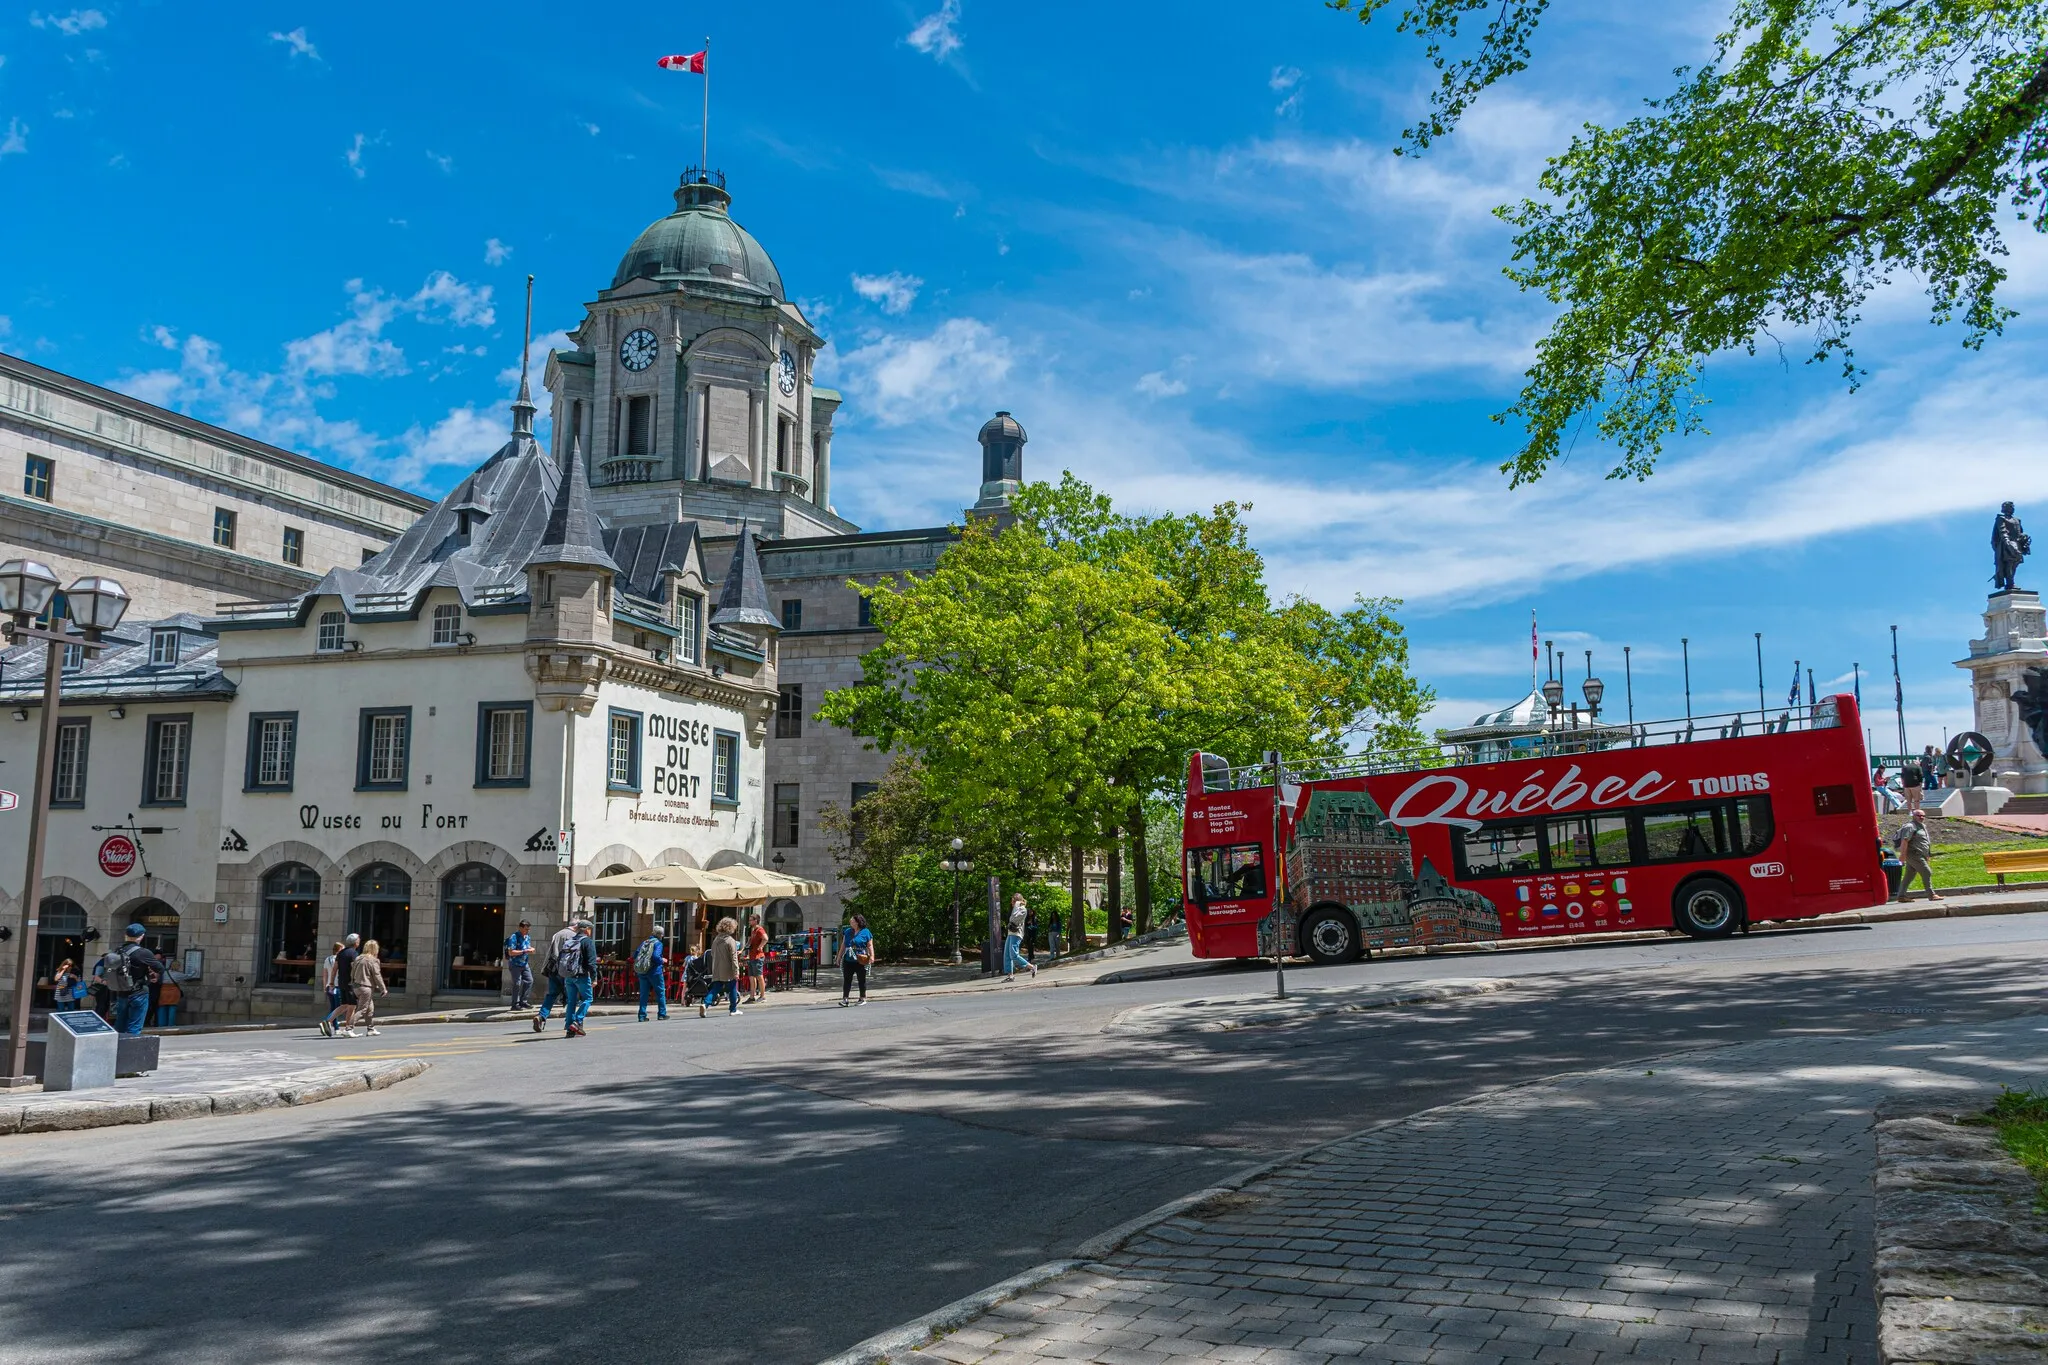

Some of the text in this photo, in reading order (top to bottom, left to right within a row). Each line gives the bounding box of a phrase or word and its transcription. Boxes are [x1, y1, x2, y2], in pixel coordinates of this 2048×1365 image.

[666, 744, 690, 770] DU
[653, 766, 700, 798] FORT
[1378, 764, 1770, 834] Québec TOURS
[1192, 811, 1204, 819] 82
[101, 849, 134, 865] Shack
[1208, 908, 1246, 916] busrouge.ca
